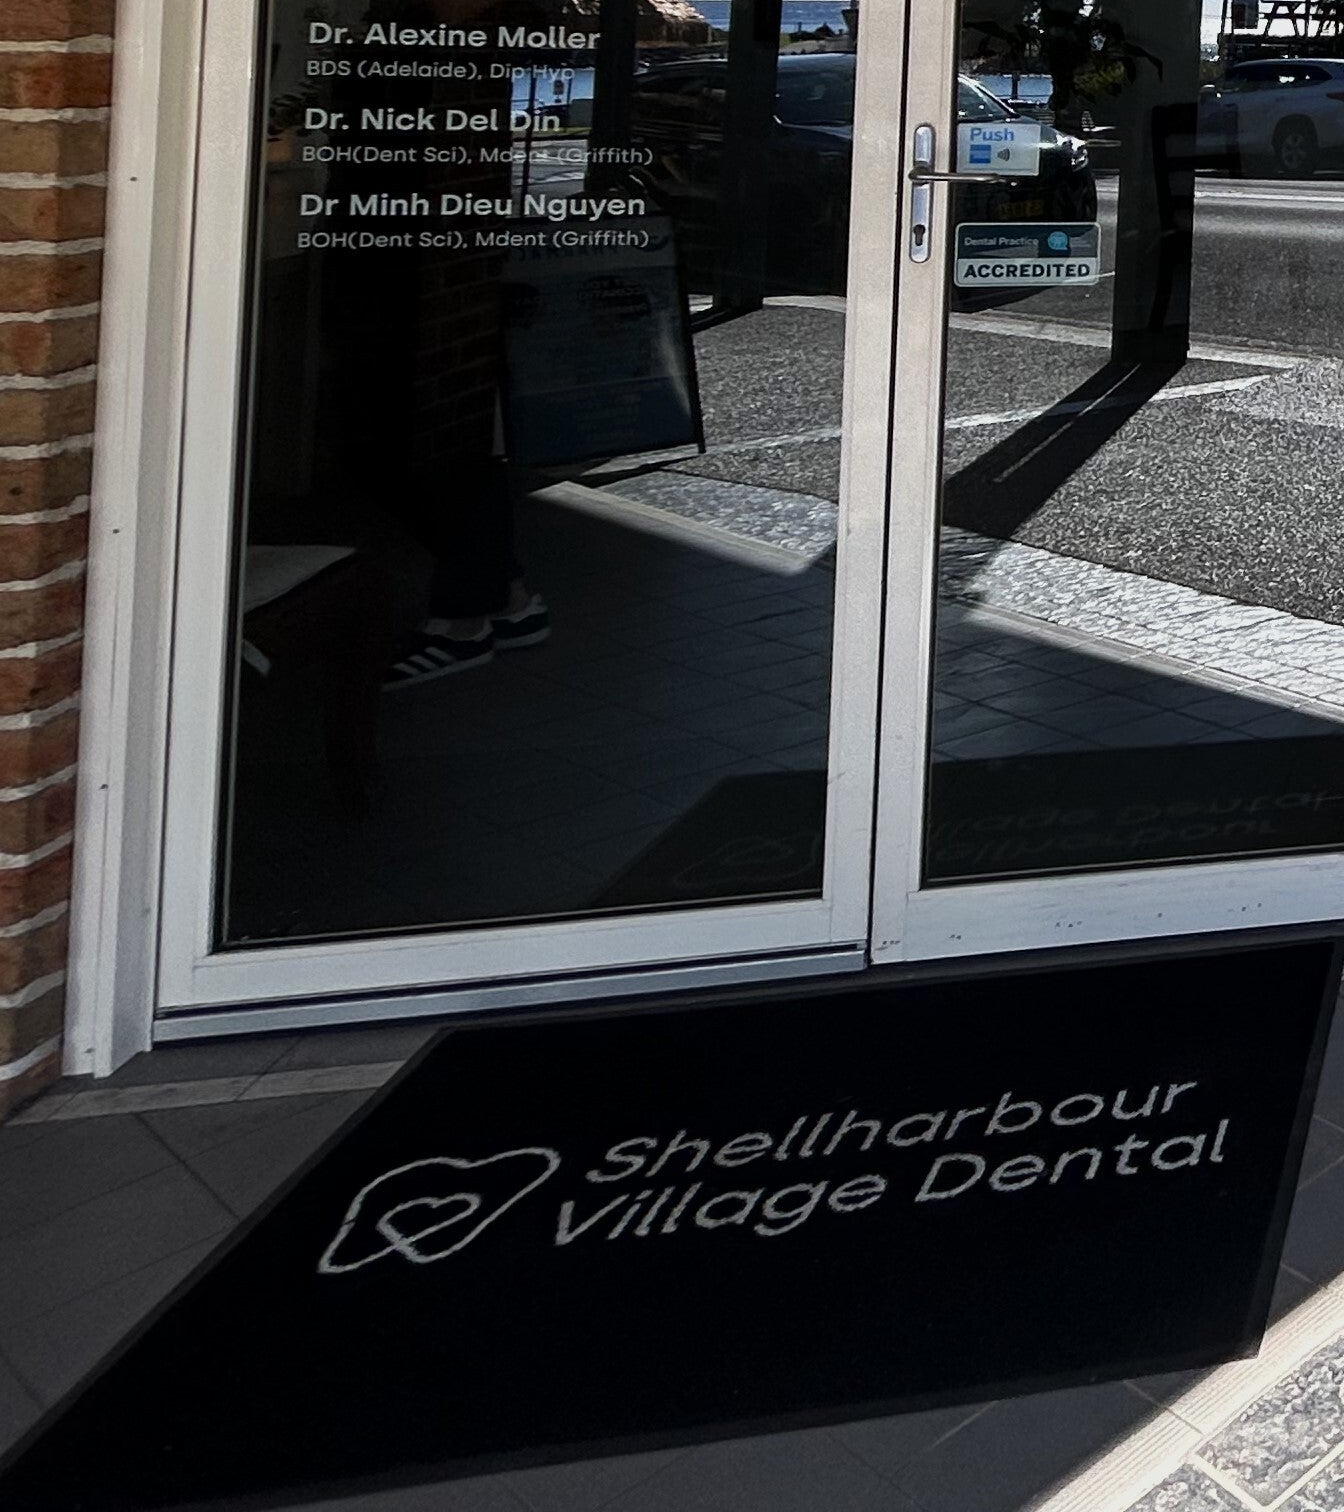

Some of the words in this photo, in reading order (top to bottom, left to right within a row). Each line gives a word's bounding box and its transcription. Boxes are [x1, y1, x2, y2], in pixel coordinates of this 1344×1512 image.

[309, 22, 353, 46] Dr.
[365, 23, 487, 48] Alexine
[498, 25, 601, 49] Moller
[306, 60, 351, 77] BDS
[358, 60, 482, 82] (Adelaide),
[490, 63, 526, 83] Dip
[533, 63, 575, 83] Hyp
[304, 108, 348, 130] Dr.
[361, 108, 434, 131] Nick
[446, 109, 498, 131] Del
[510, 110, 560, 132] Din
[970, 127, 1015, 142] Push
[302, 145, 418, 166] BOH(Dent
[424, 145, 472, 166] Sci),
[557, 146, 654, 166] (Griffith)
[301, 193, 339, 216] Dr
[349, 193, 430, 216] Minh
[441, 193, 512, 217] Dieu
[524, 194, 646, 222] Nguyen
[298, 230, 413, 250] BOH(Dent
[419, 229, 468, 250] Sci),
[475, 229, 546, 248] Mdent
[552, 228, 650, 250] (Griffith)
[964, 236, 997, 246] Dental
[998, 237, 1039, 246] Practice
[963, 263, 1090, 278] ACCREDITED
[586, 1079, 1198, 1184] Shellharbour
[555, 1172, 887, 1247] Village
[915, 1120, 1229, 1203] Dental
